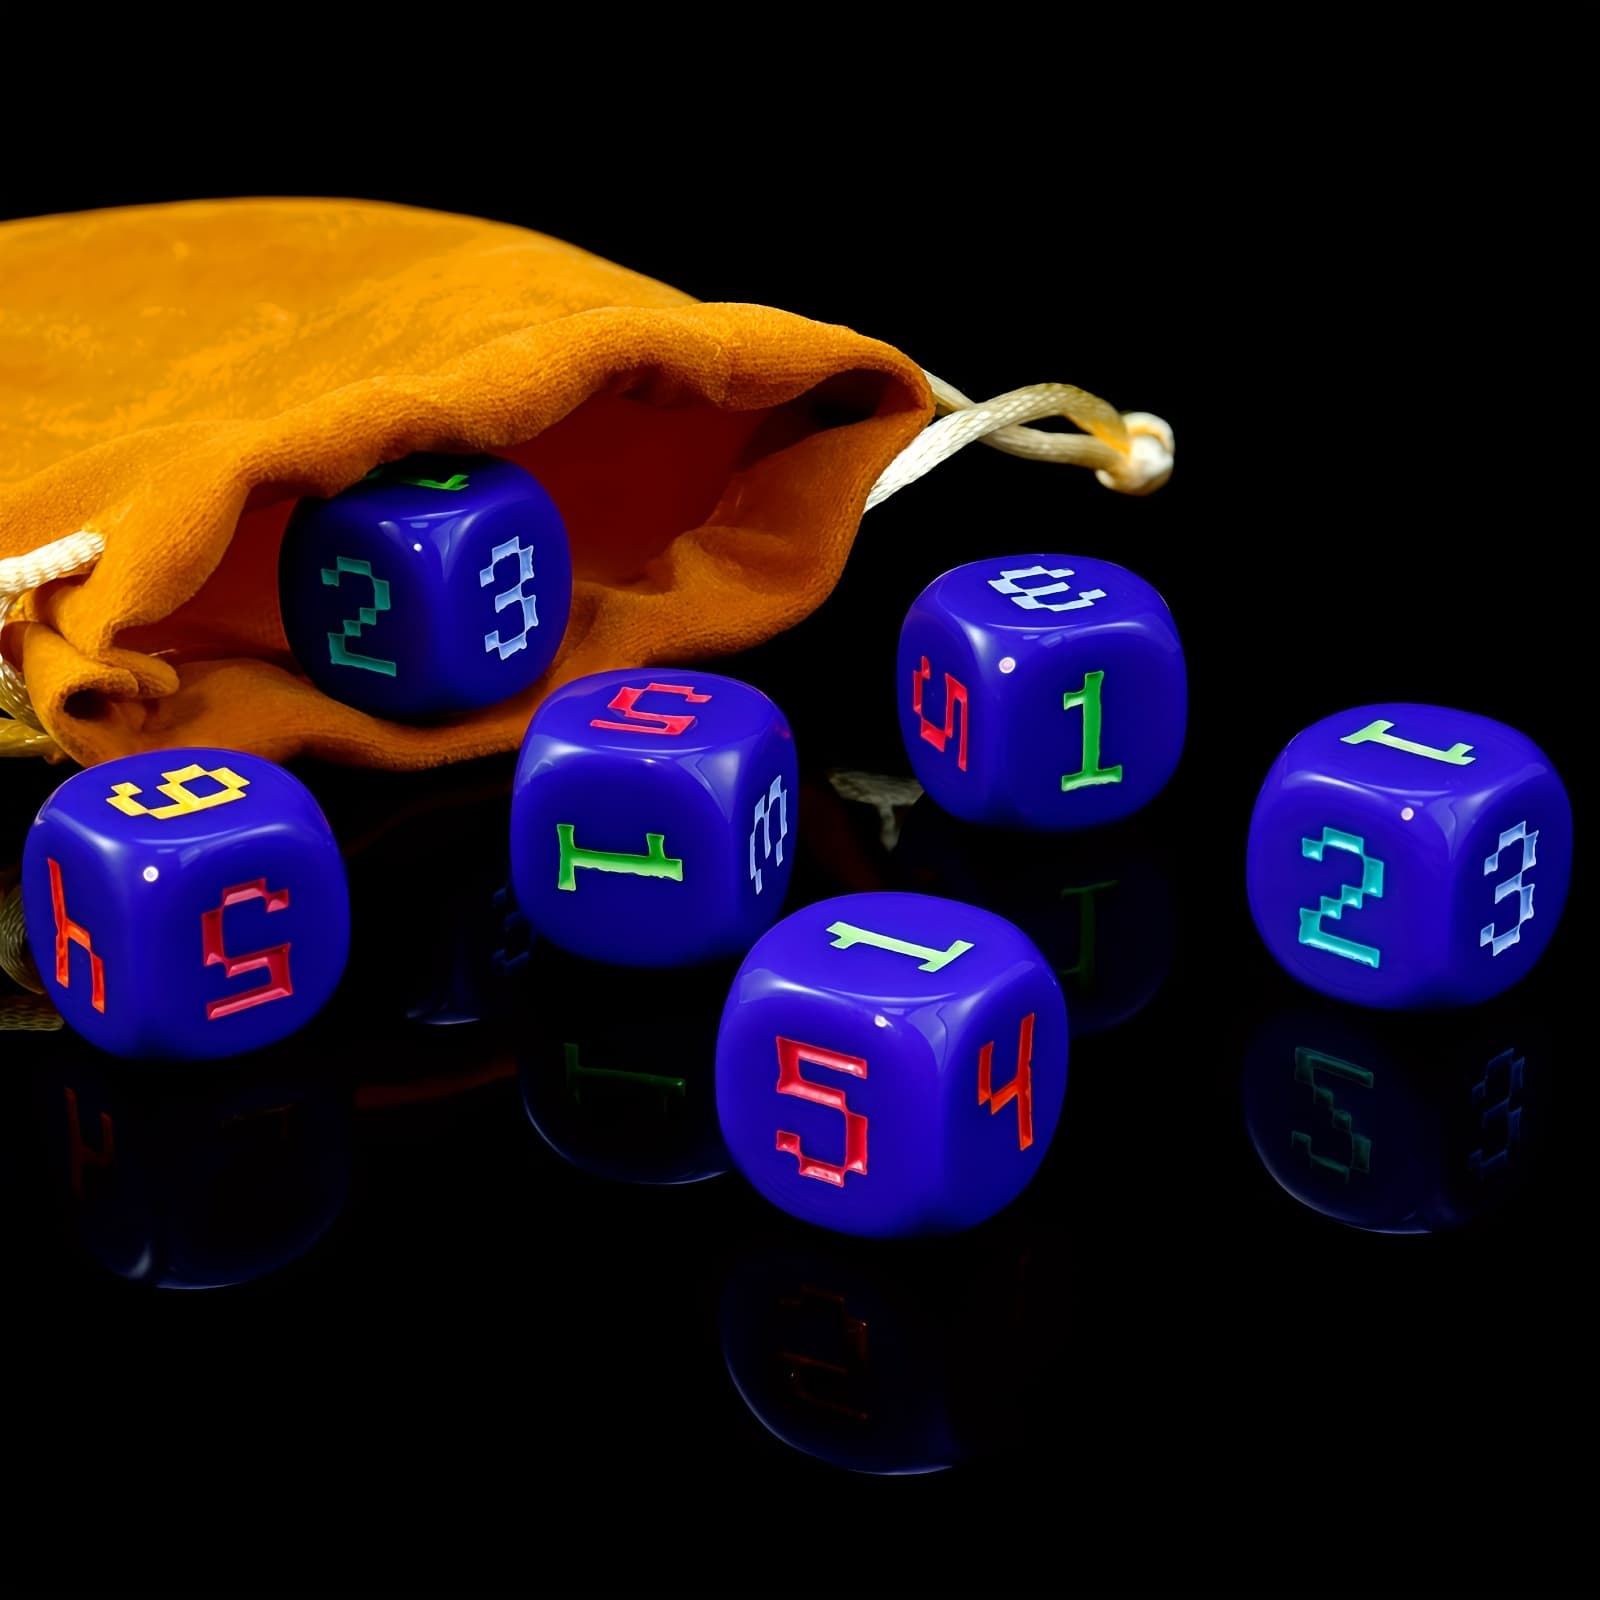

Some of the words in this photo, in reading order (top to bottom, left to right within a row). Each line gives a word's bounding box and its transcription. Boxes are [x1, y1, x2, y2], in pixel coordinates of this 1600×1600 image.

[322, 558, 397, 677] 2
[480, 537, 538, 660] 3
[988, 566, 1106, 611] 3
[590, 683, 711, 735] 5
[913, 656, 968, 771] 5
[1061, 671, 1122, 791] 1
[1341, 720, 1475, 765] 1
[556, 824, 683, 891] 1
[1299, 828, 1383, 968] 2
[1480, 822, 1538, 956] 3
[48, 858, 106, 1013] 4
[201, 878, 293, 1020] 5
[826, 921, 974, 972] 1
[776, 1036, 869, 1187] 5
[978, 1013, 1035, 1151] 4
